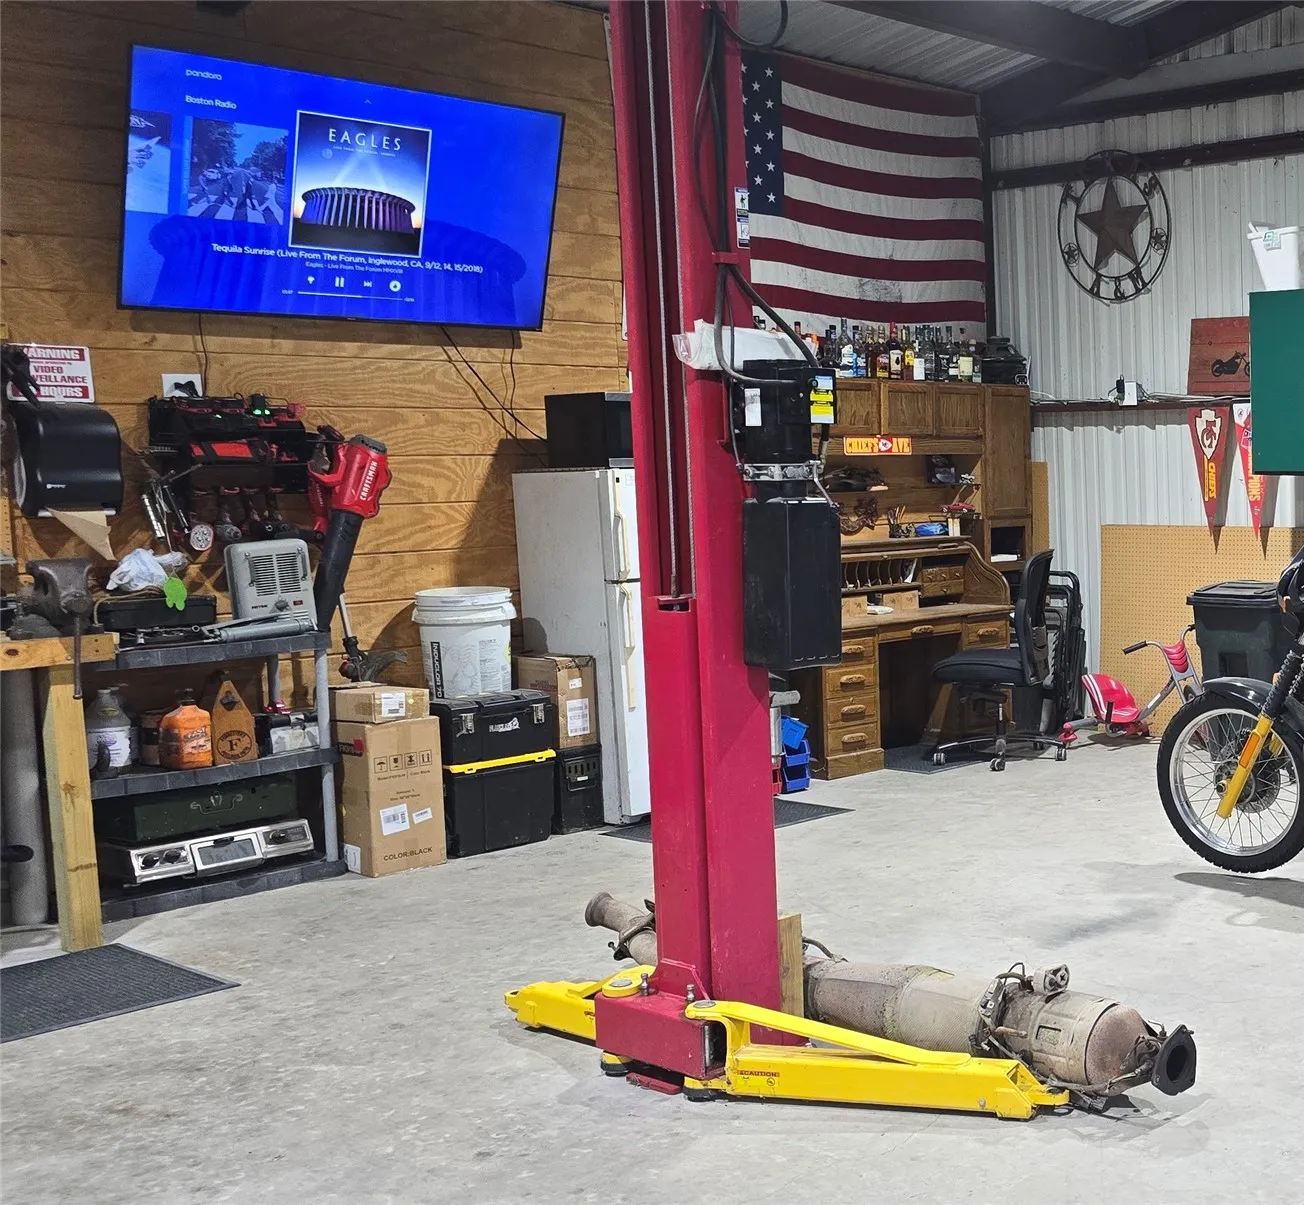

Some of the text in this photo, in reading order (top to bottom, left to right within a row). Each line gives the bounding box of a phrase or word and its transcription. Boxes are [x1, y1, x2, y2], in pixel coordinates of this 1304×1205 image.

[185, 69, 222, 80] pandora
[185, 95, 237, 109] Boston Radio
[329, 128, 401, 151] EAGLES
[211, 243, 242, 254] Tequila
[244, 246, 275, 256] Sunrise
[276, 249, 298, 258] (Live
[299, 251, 321, 260] From
[323, 253, 338, 261] The
[339, 254, 367, 264] Forum,
[368, 257, 409, 268] Inglewood,
[33, 365, 64, 374] VIDEO
[32, 374, 88, 384] VEILLANCE
[40, 386, 83, 397] HOURS
[846, 437, 878, 453] CHIEFS
[892, 438, 910, 452] AVE
[360, 460, 378, 501] CRAFTSMAN
[1208, 462, 1217, 499] CHIEFS
[228, 738, 241, 751] F
[384, 846, 433, 861] COLOR:BLACK
